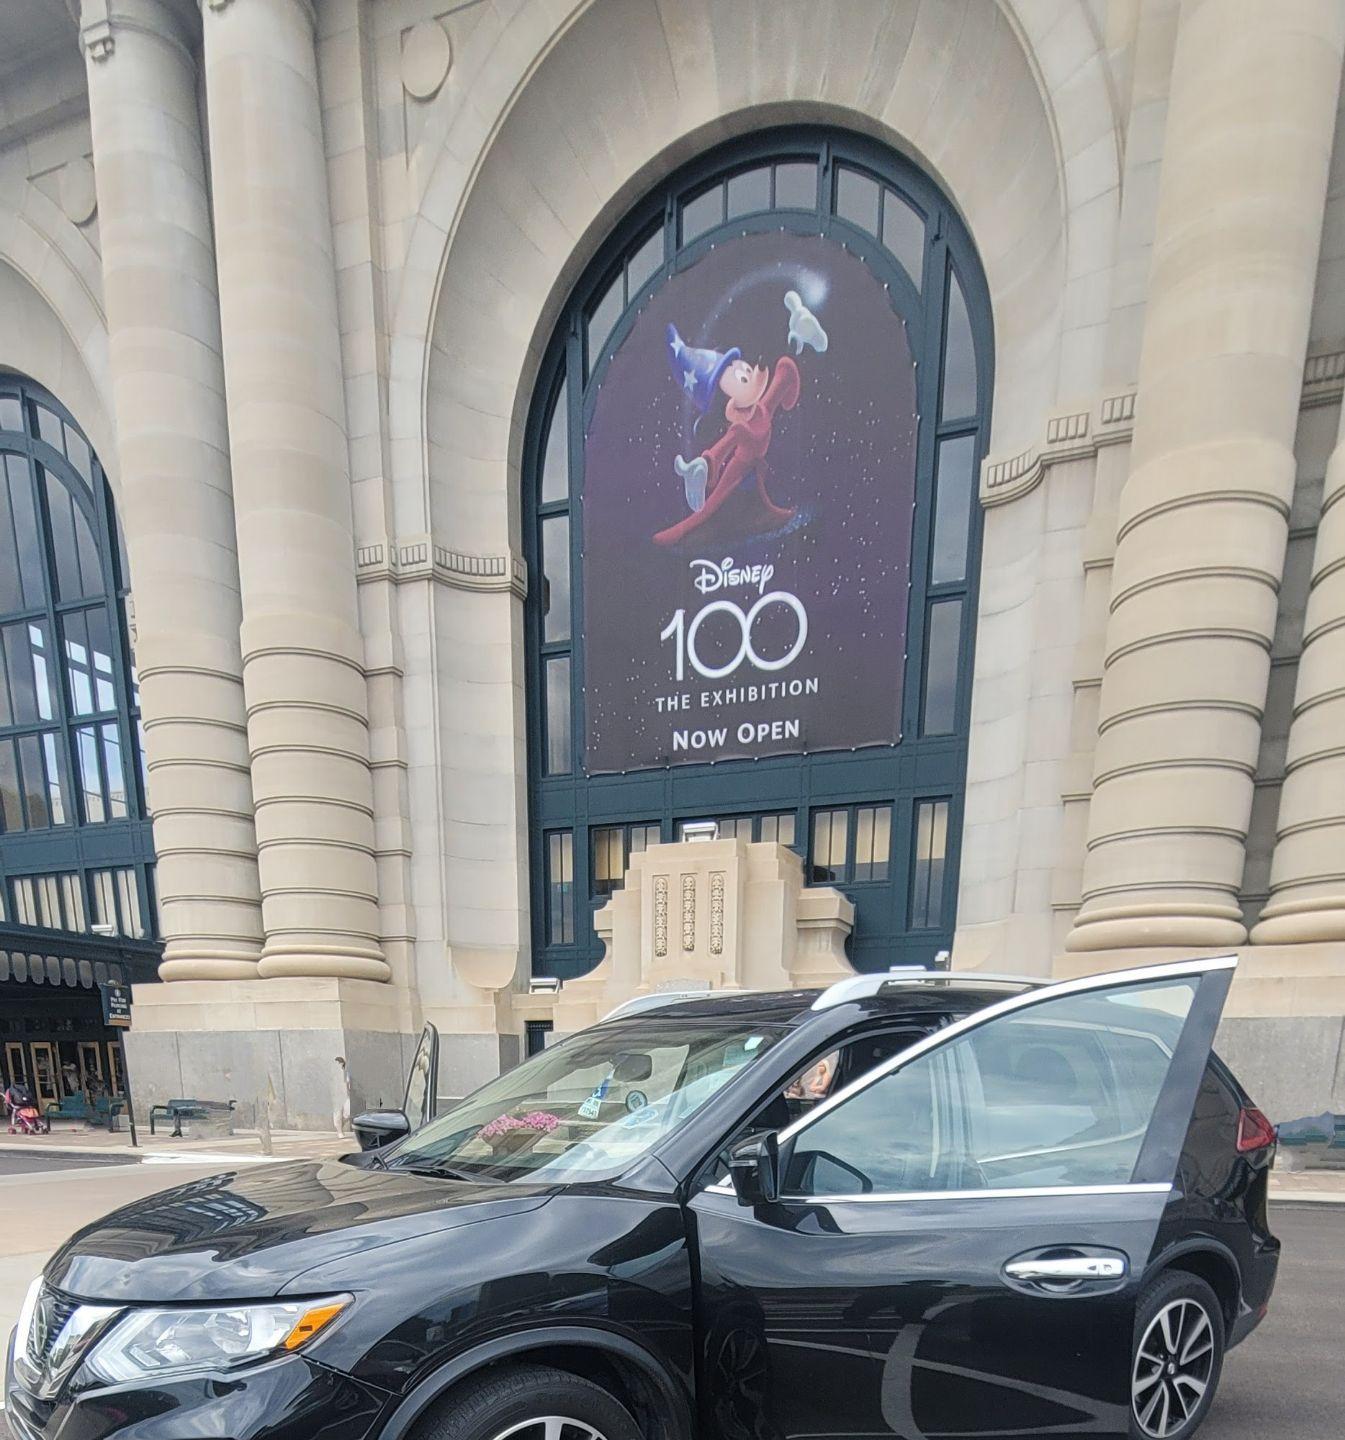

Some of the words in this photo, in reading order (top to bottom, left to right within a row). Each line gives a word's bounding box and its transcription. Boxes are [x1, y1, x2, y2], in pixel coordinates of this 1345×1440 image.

[689, 557, 774, 594] Disney
[660, 591, 808, 681] 100
[655, 695, 691, 713] THE
[701, 677, 819, 708] EXHIBITION
[673, 728, 728, 751] NOW
[737, 719, 800, 744] OPEN
